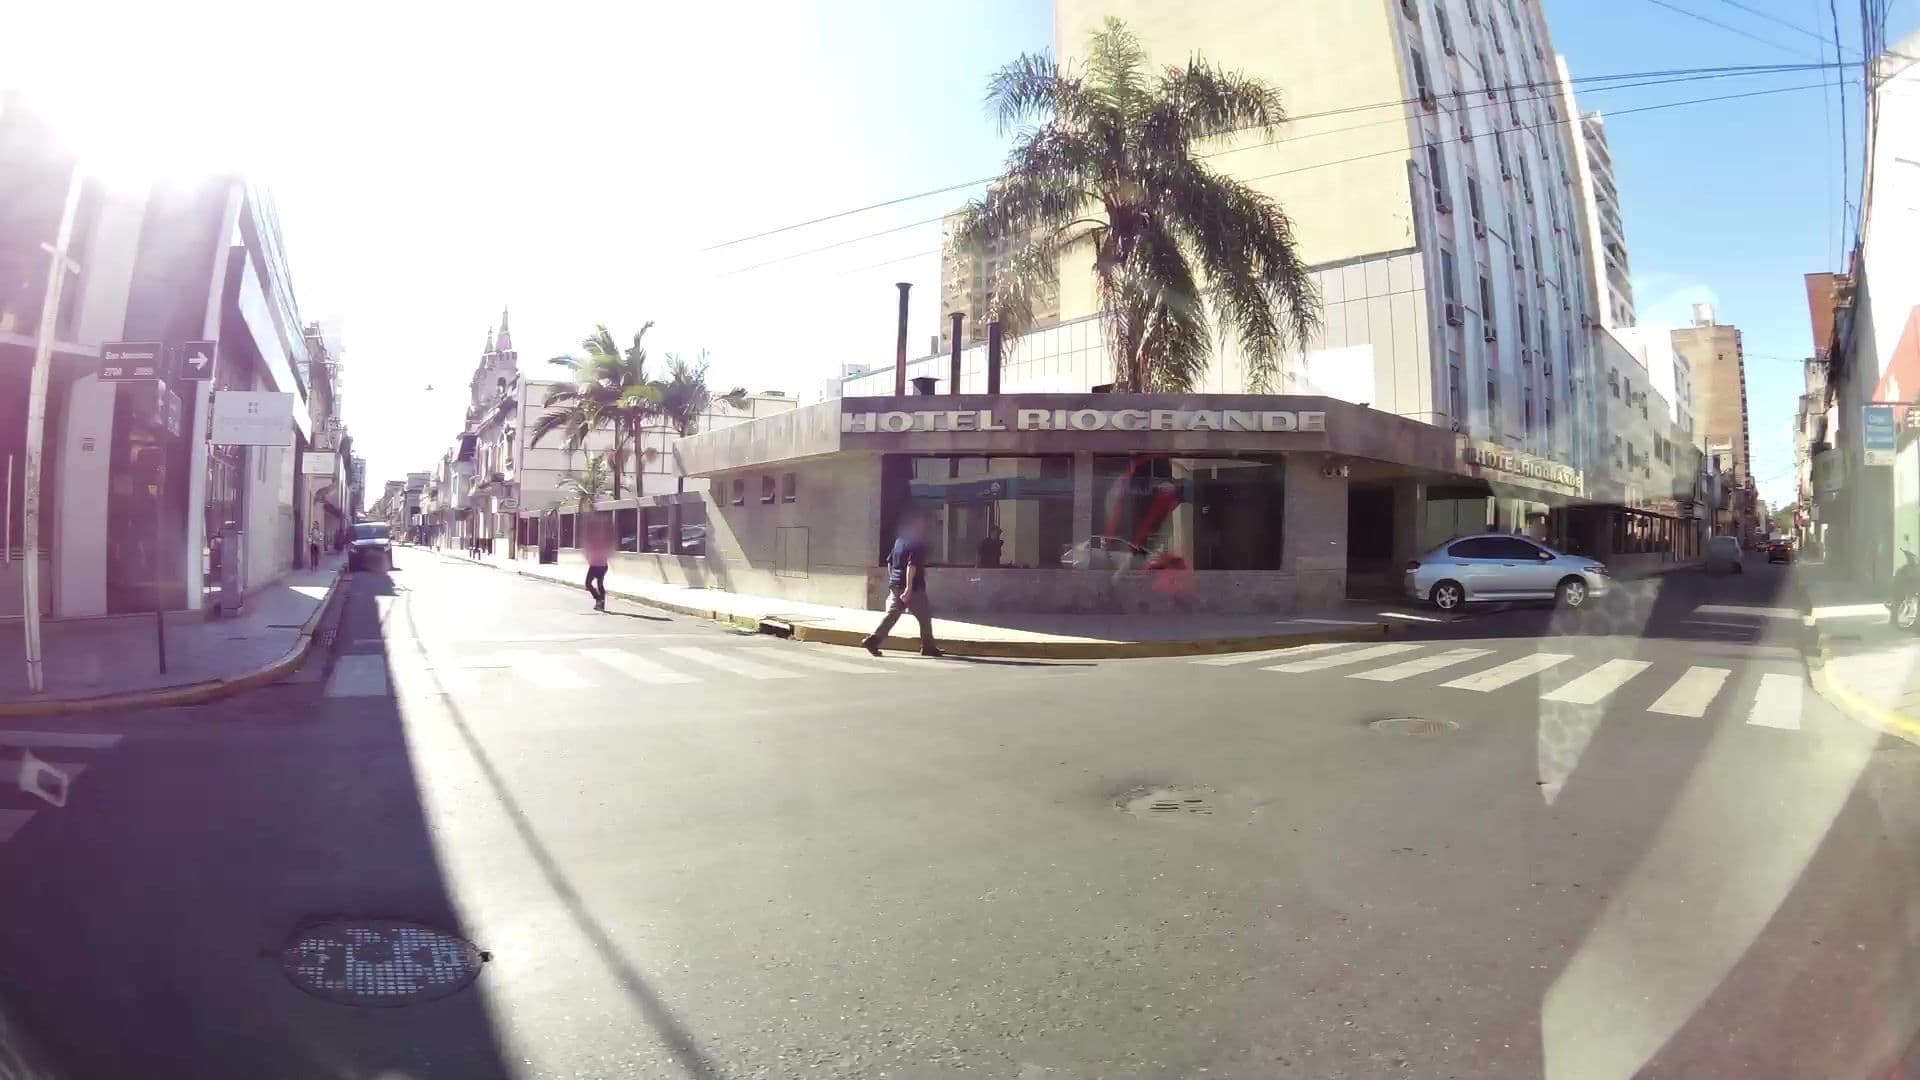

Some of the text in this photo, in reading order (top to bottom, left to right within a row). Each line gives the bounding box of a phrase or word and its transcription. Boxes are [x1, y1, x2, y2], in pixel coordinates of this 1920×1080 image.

[841, 408, 1326, 432] HOTEL RIOGRANDE
[1475, 447, 1521, 473] HOTEL
